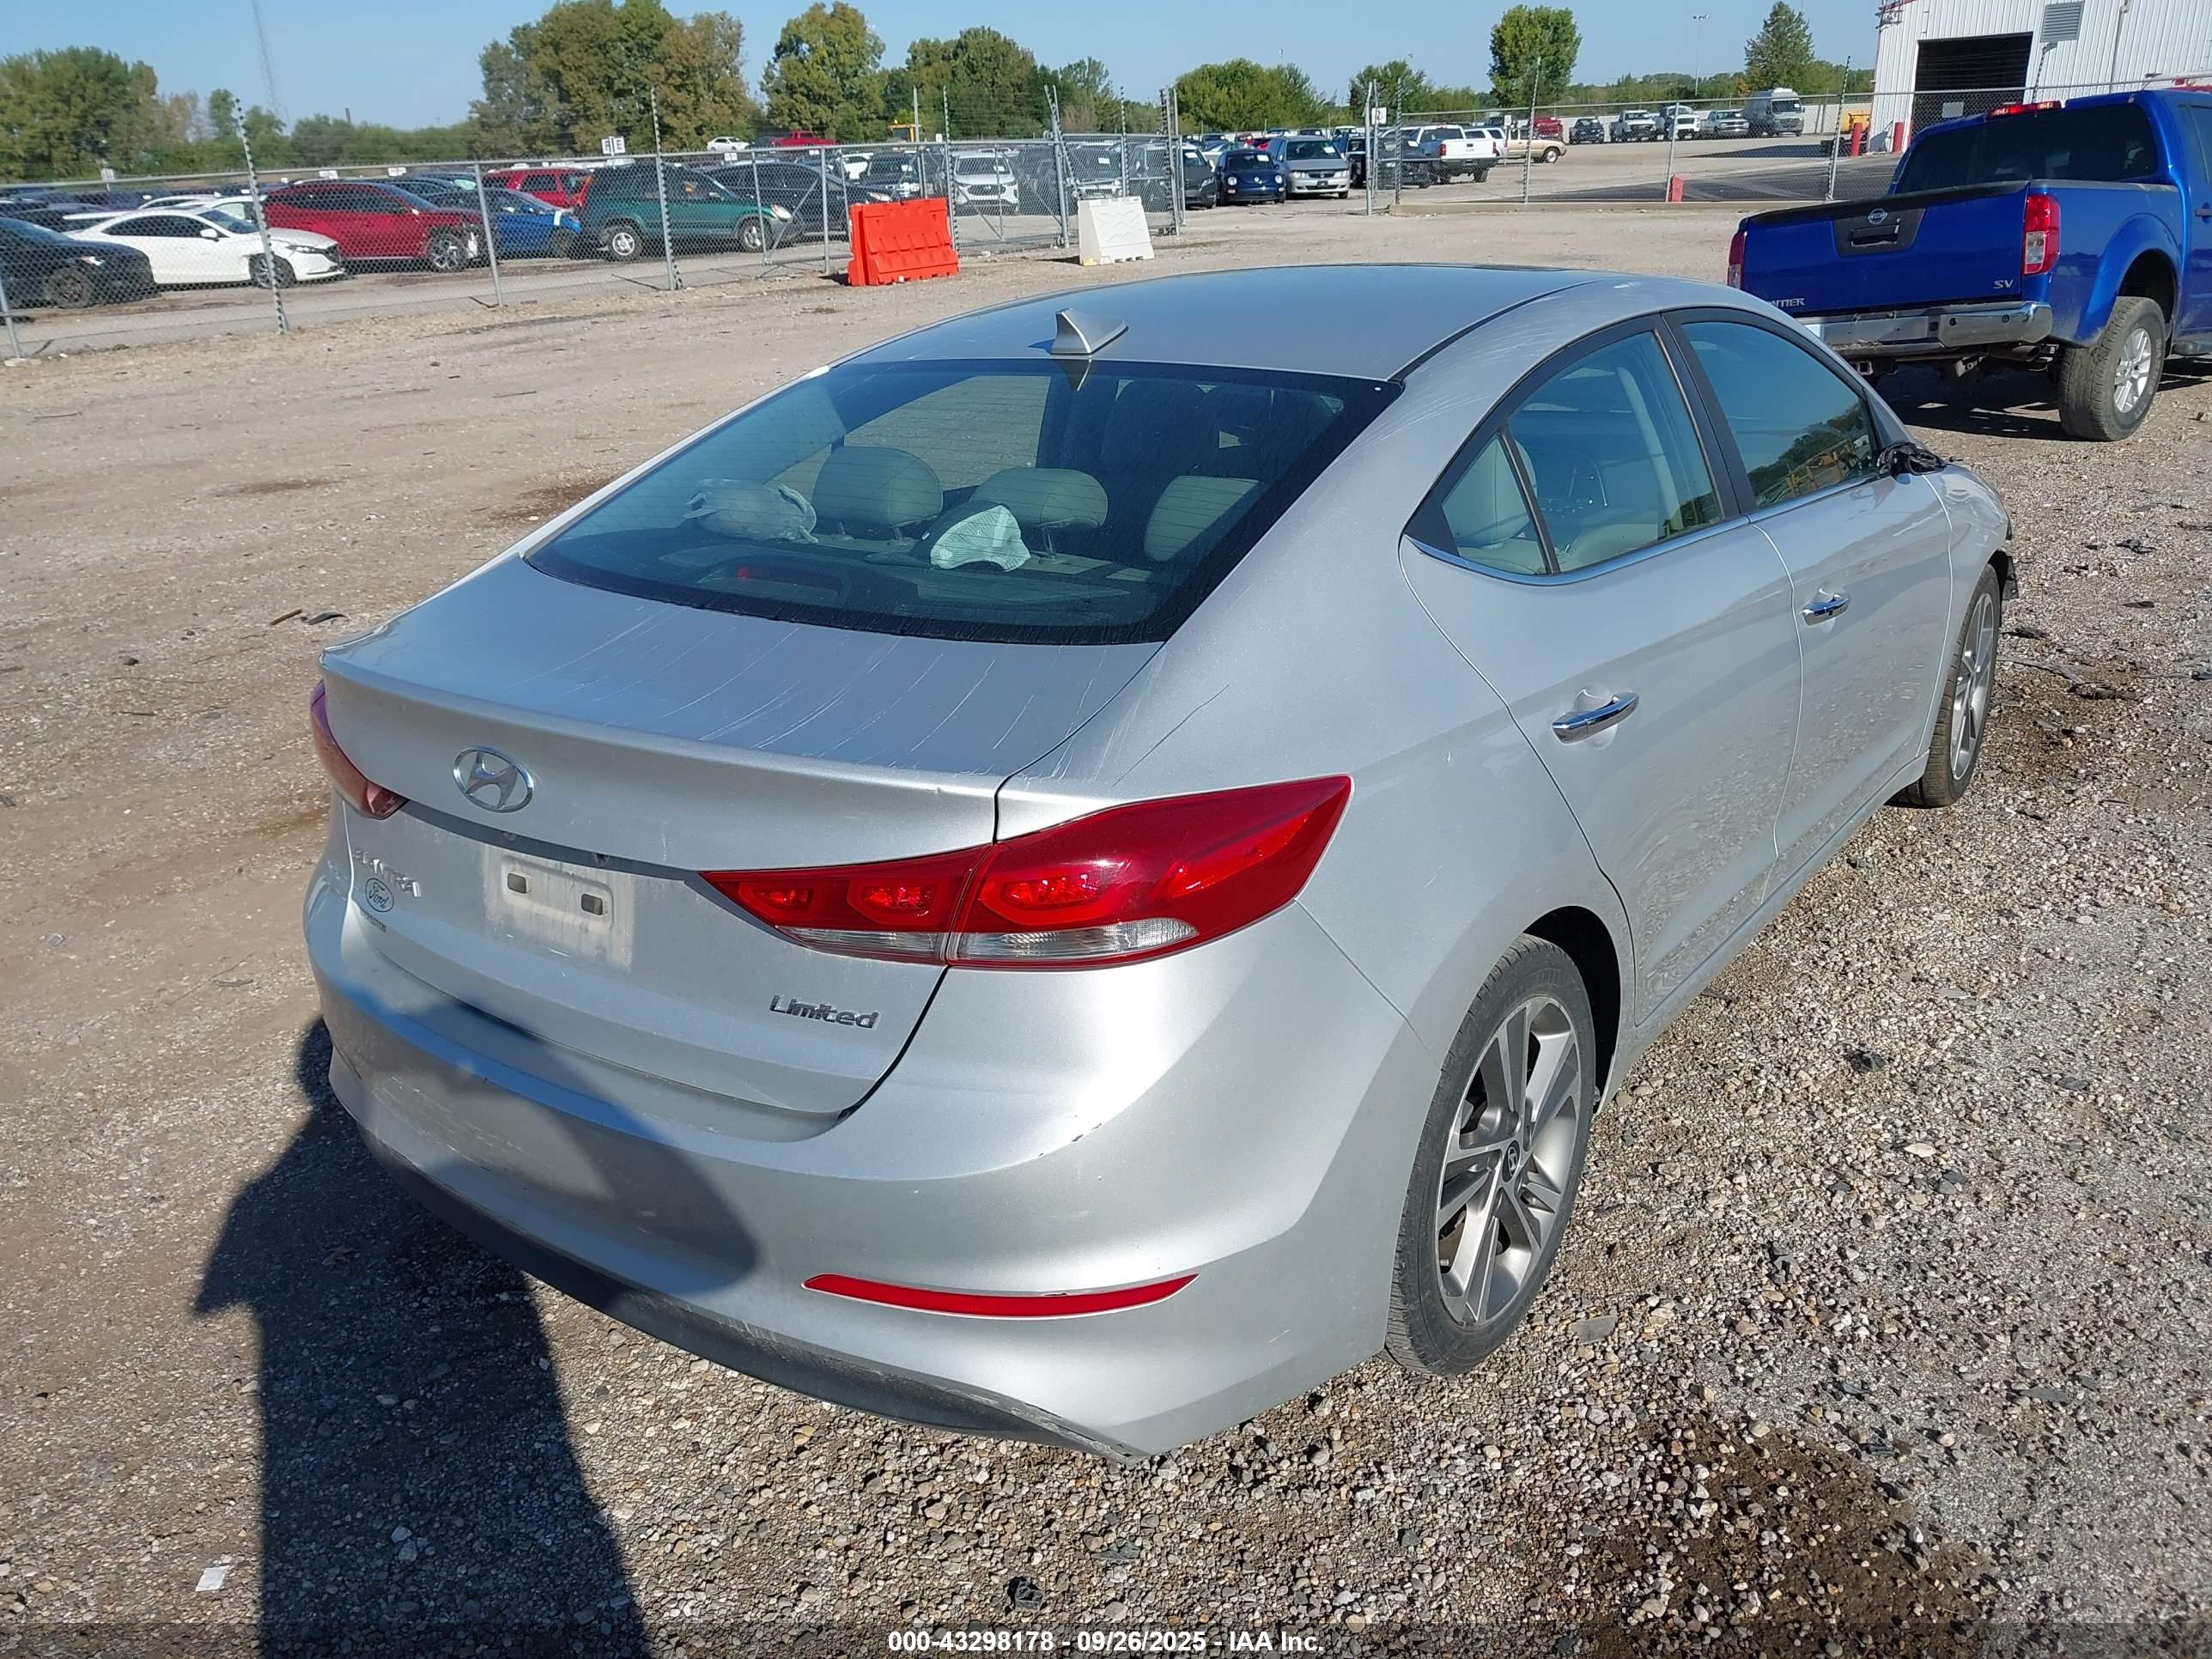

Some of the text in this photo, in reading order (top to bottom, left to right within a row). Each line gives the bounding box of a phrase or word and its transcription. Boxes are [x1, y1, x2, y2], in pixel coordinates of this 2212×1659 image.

[1993, 278, 2014, 289] SV
[1770, 297, 1805, 308] NTIER
[368, 881, 390, 908] Ford
[769, 994, 880, 1030] Limited
